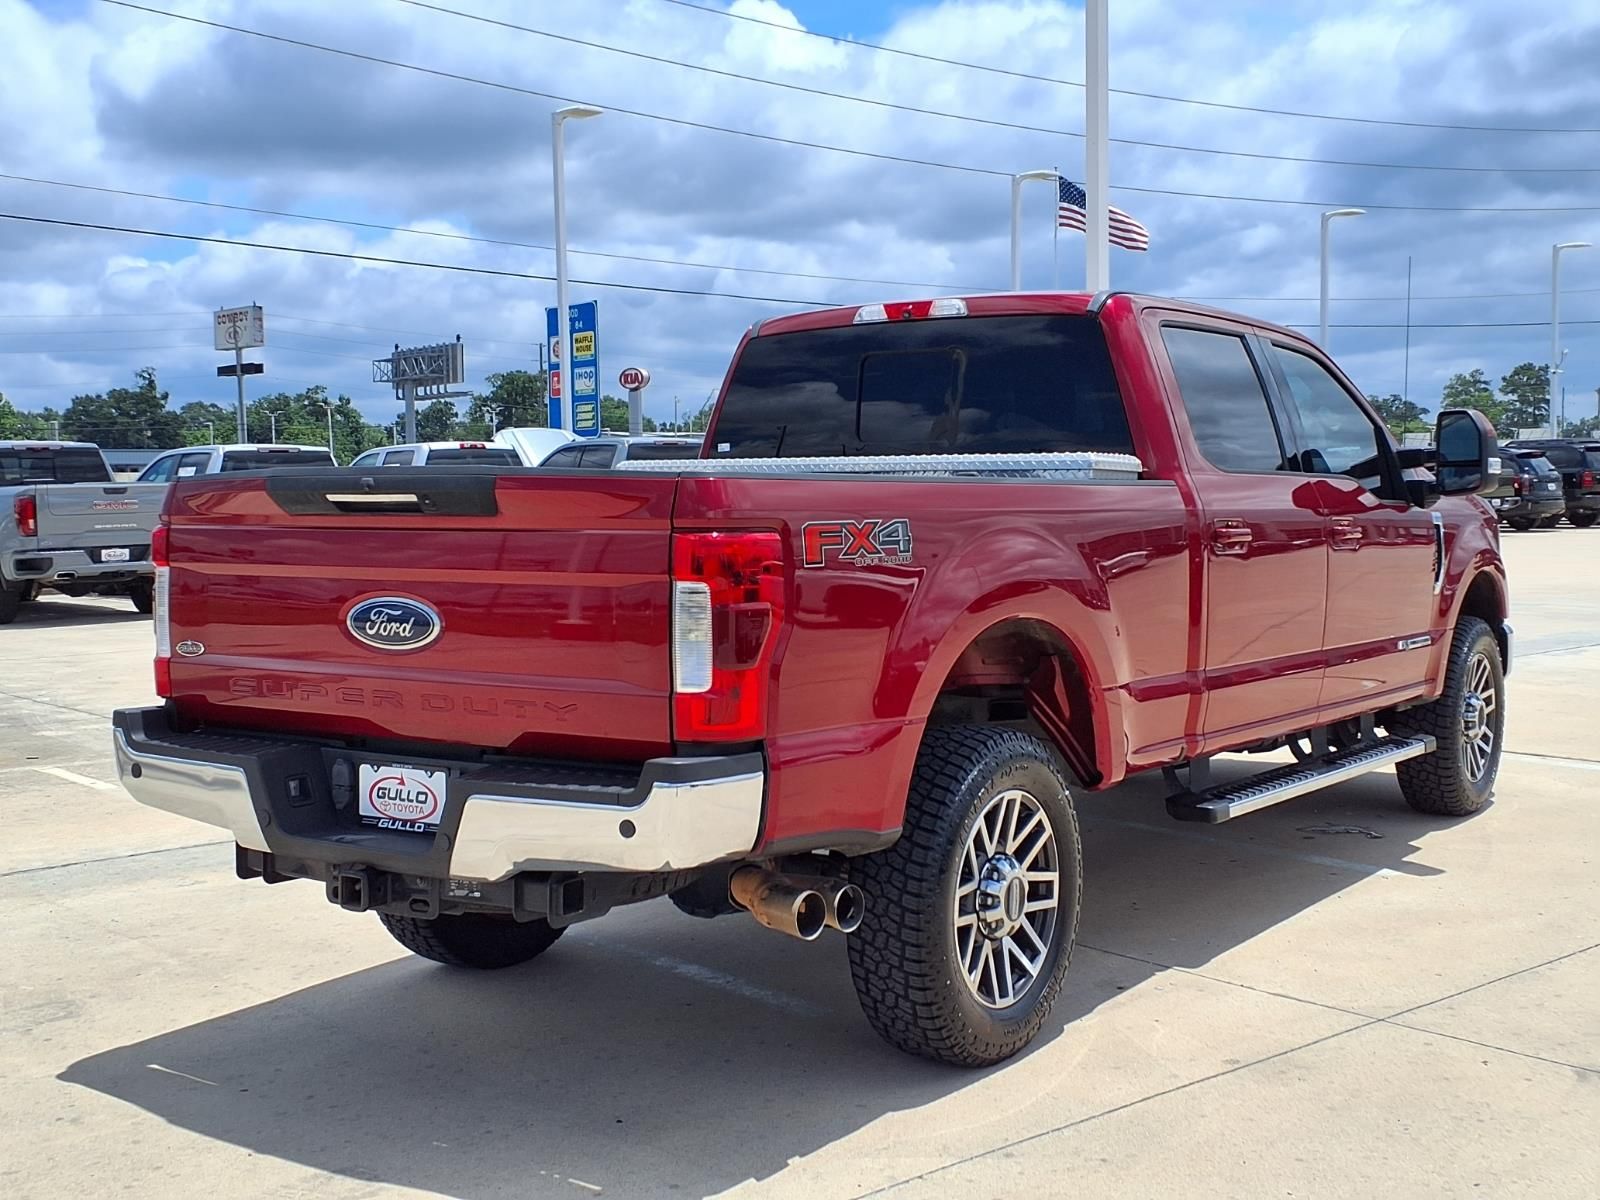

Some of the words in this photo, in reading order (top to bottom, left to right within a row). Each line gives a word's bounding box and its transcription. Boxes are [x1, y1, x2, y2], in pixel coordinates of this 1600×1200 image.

[217, 311, 249, 325] COWBOY
[574, 335, 593, 345] WAFFLE
[575, 344, 592, 354] HOUSE
[623, 372, 640, 385] KIA
[801, 518, 913, 568] FX4
[365, 607, 415, 637] Ford
[228, 676, 404, 709] SUPER
[420, 690, 579, 722] DUTY
[376, 786, 429, 804] GULLO
[392, 803, 425, 815] TOYOTA
[378, 818, 424, 832] GULLO
